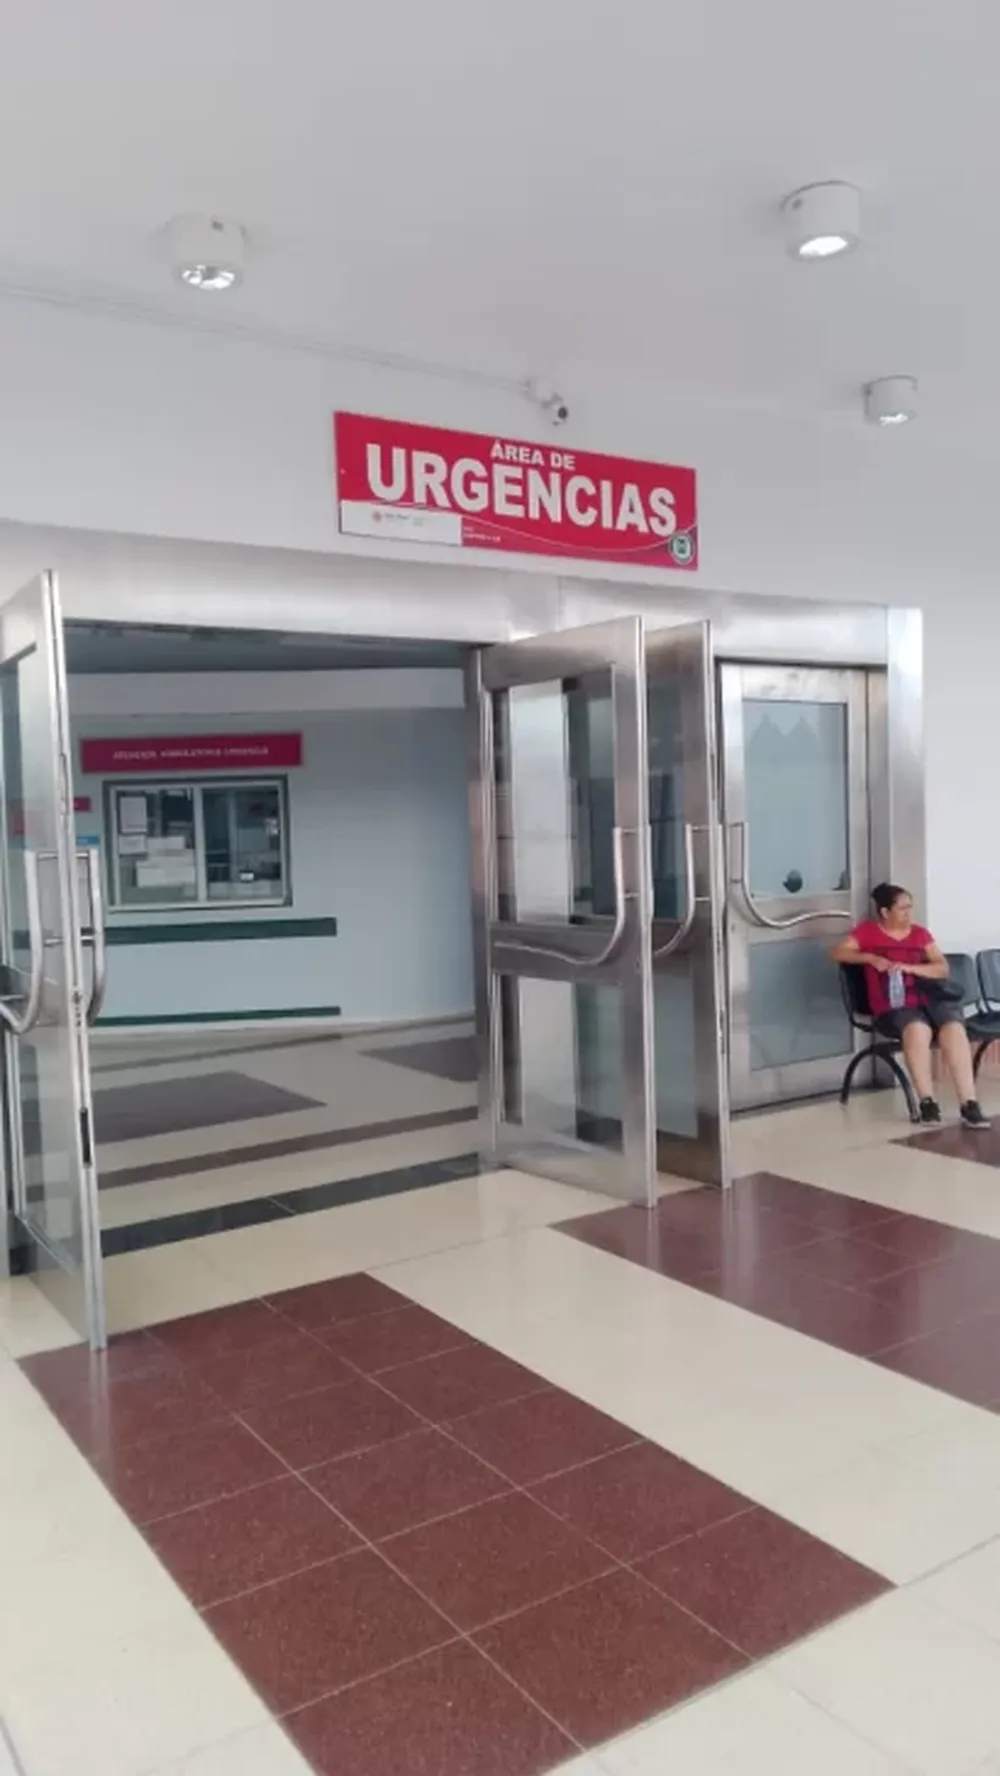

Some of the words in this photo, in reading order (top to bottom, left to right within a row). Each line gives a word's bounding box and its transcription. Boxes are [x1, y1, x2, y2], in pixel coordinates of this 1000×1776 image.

[490, 440, 544, 466] ÁREA
[550, 451, 576, 471] DE
[366, 443, 677, 537] URGENCIAS
